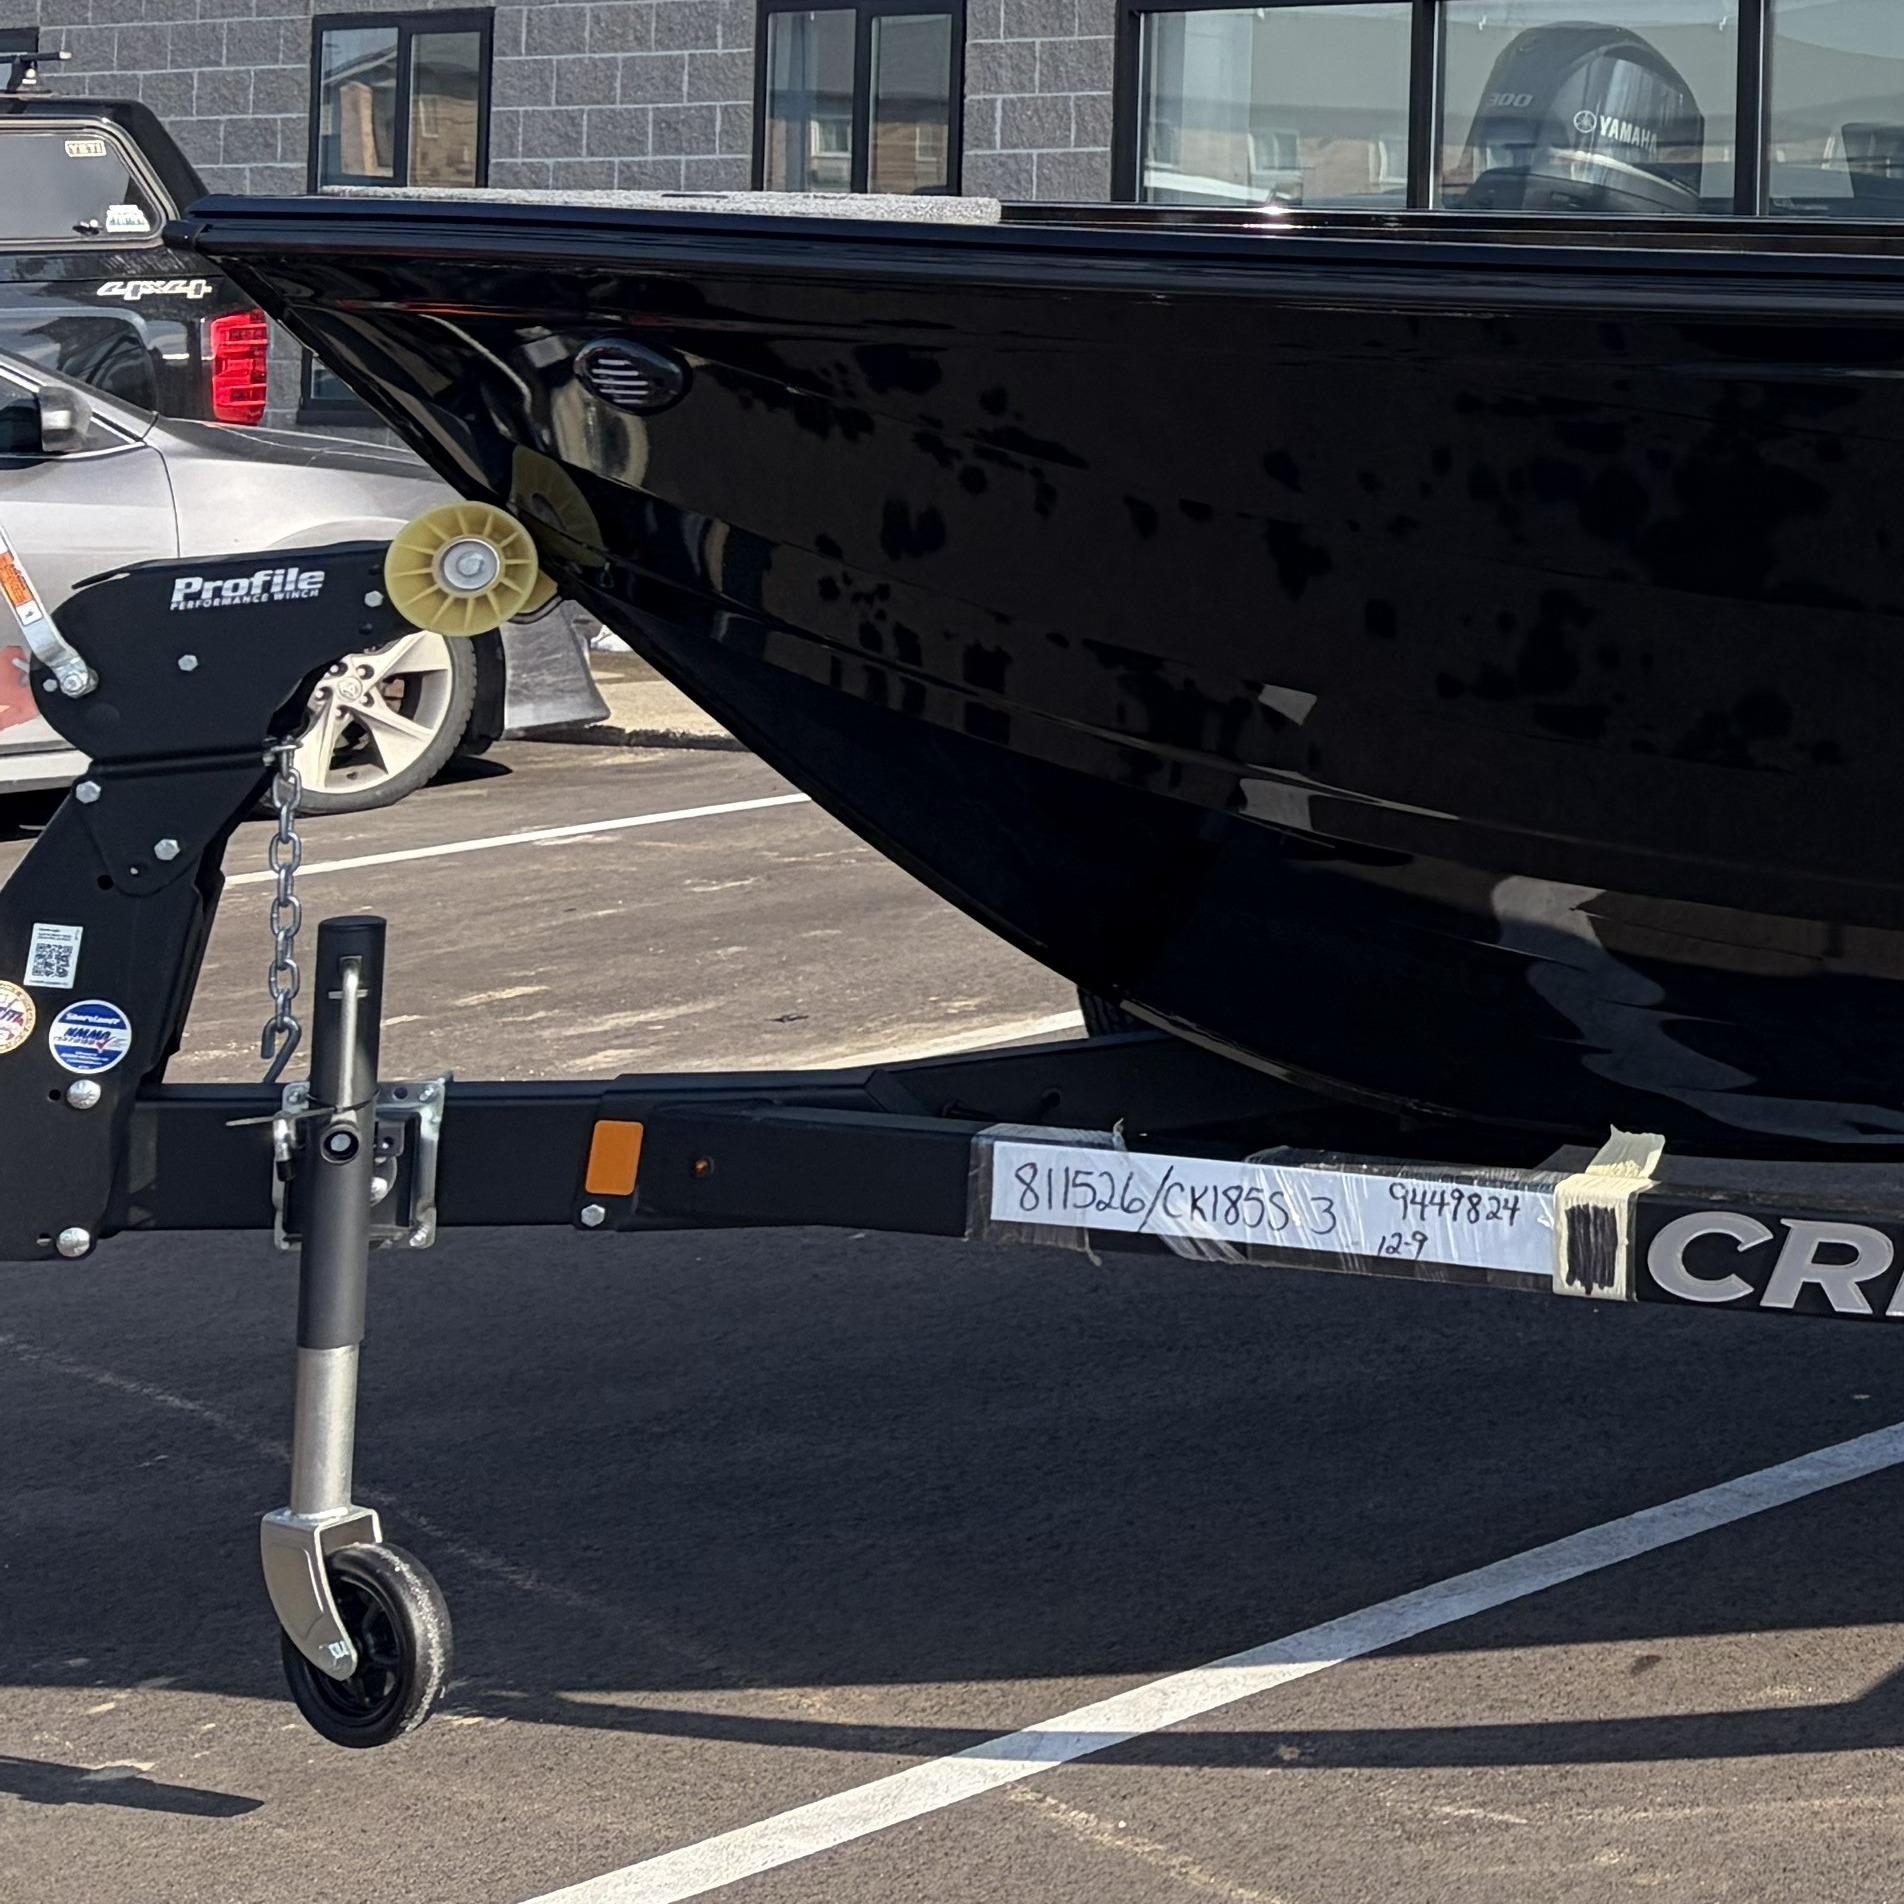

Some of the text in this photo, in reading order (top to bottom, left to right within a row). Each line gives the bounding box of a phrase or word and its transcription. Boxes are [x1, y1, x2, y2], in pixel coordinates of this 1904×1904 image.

[1487, 93, 1534, 108] 300
[1599, 114, 1658, 154] YAMAHA
[170, 589, 319, 611] PERFORMANCE WINCH
[171, 567, 325, 602] Profile
[1389, 1182, 1520, 1227] 9449824
[1377, 1230, 1428, 1260] 12-9
